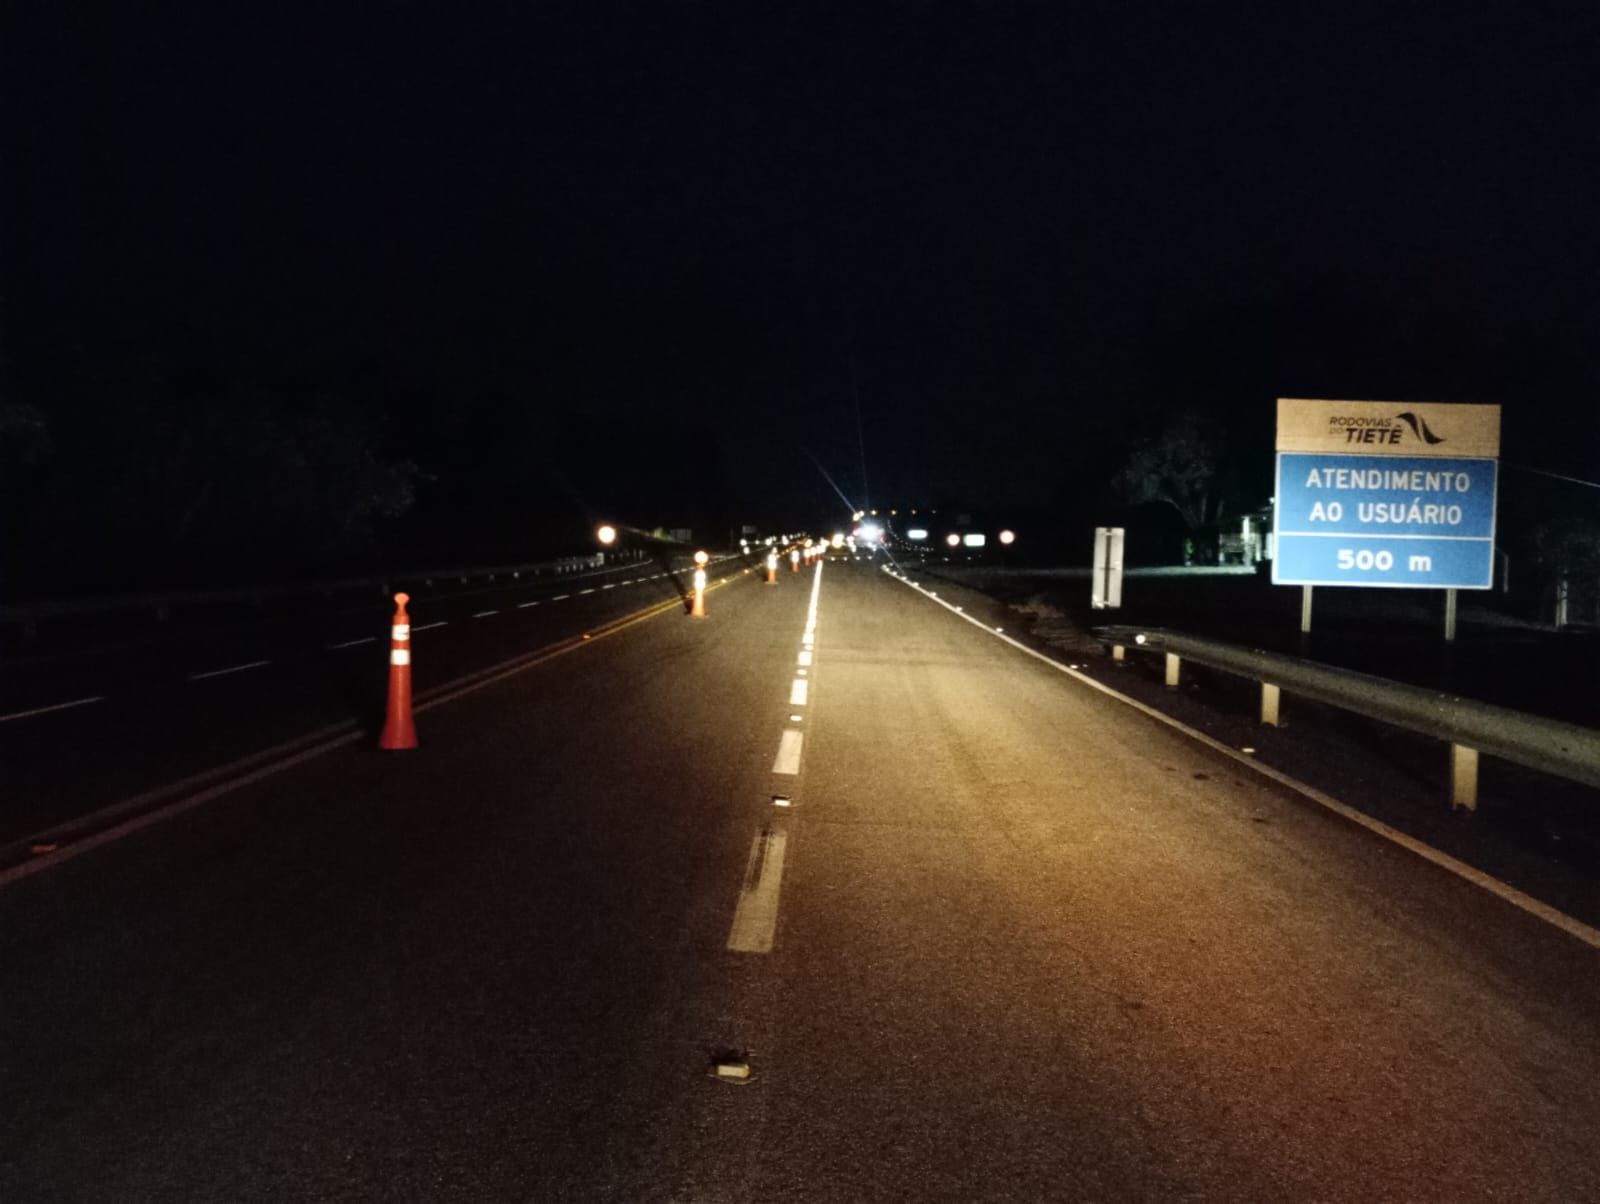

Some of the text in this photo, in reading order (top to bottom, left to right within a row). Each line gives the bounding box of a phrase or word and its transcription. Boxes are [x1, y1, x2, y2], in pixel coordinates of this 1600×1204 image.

[1329, 416, 1392, 427] RODOVIAS
[1345, 424, 1404, 444] TIETÊ
[1305, 468, 1471, 493] ATENDIMENTO
[1308, 497, 1462, 525] AO USUÁRIO
[1337, 549, 1432, 572] 500 m
